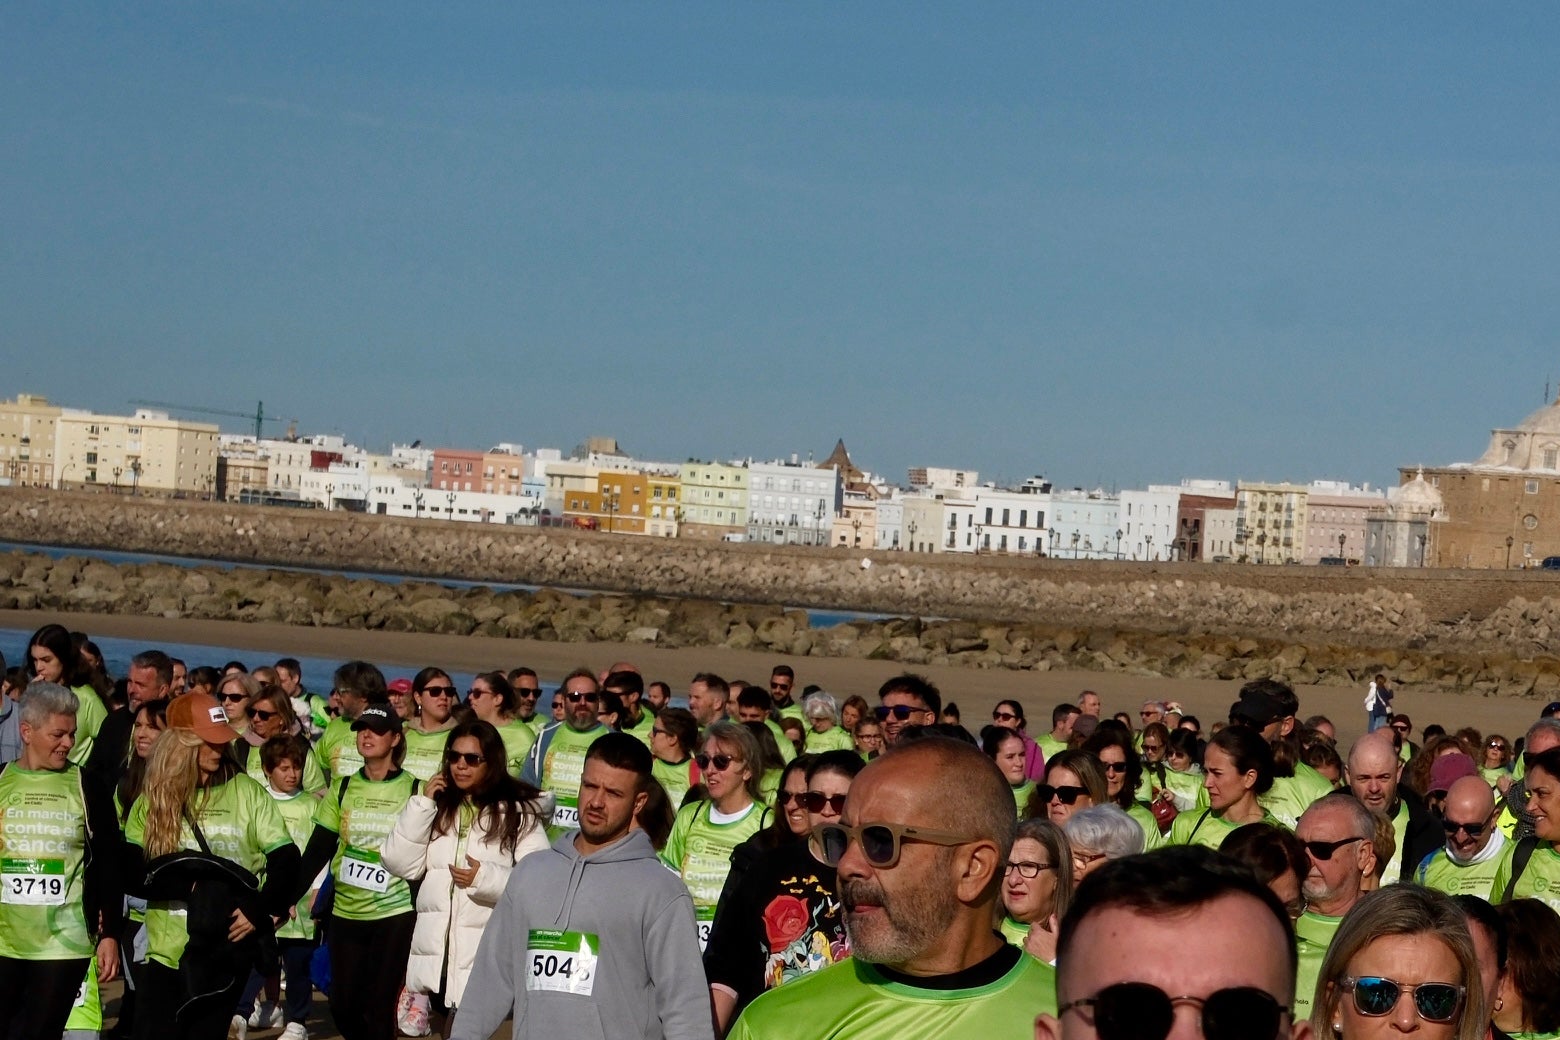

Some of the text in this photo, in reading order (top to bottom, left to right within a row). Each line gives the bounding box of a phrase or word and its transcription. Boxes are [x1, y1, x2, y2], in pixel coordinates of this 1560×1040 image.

[6, 808, 24, 818] En
[351, 810, 365, 820] En
[5, 822, 63, 836] contra
[348, 862, 386, 884] 1776
[12, 878, 61, 895] 3719
